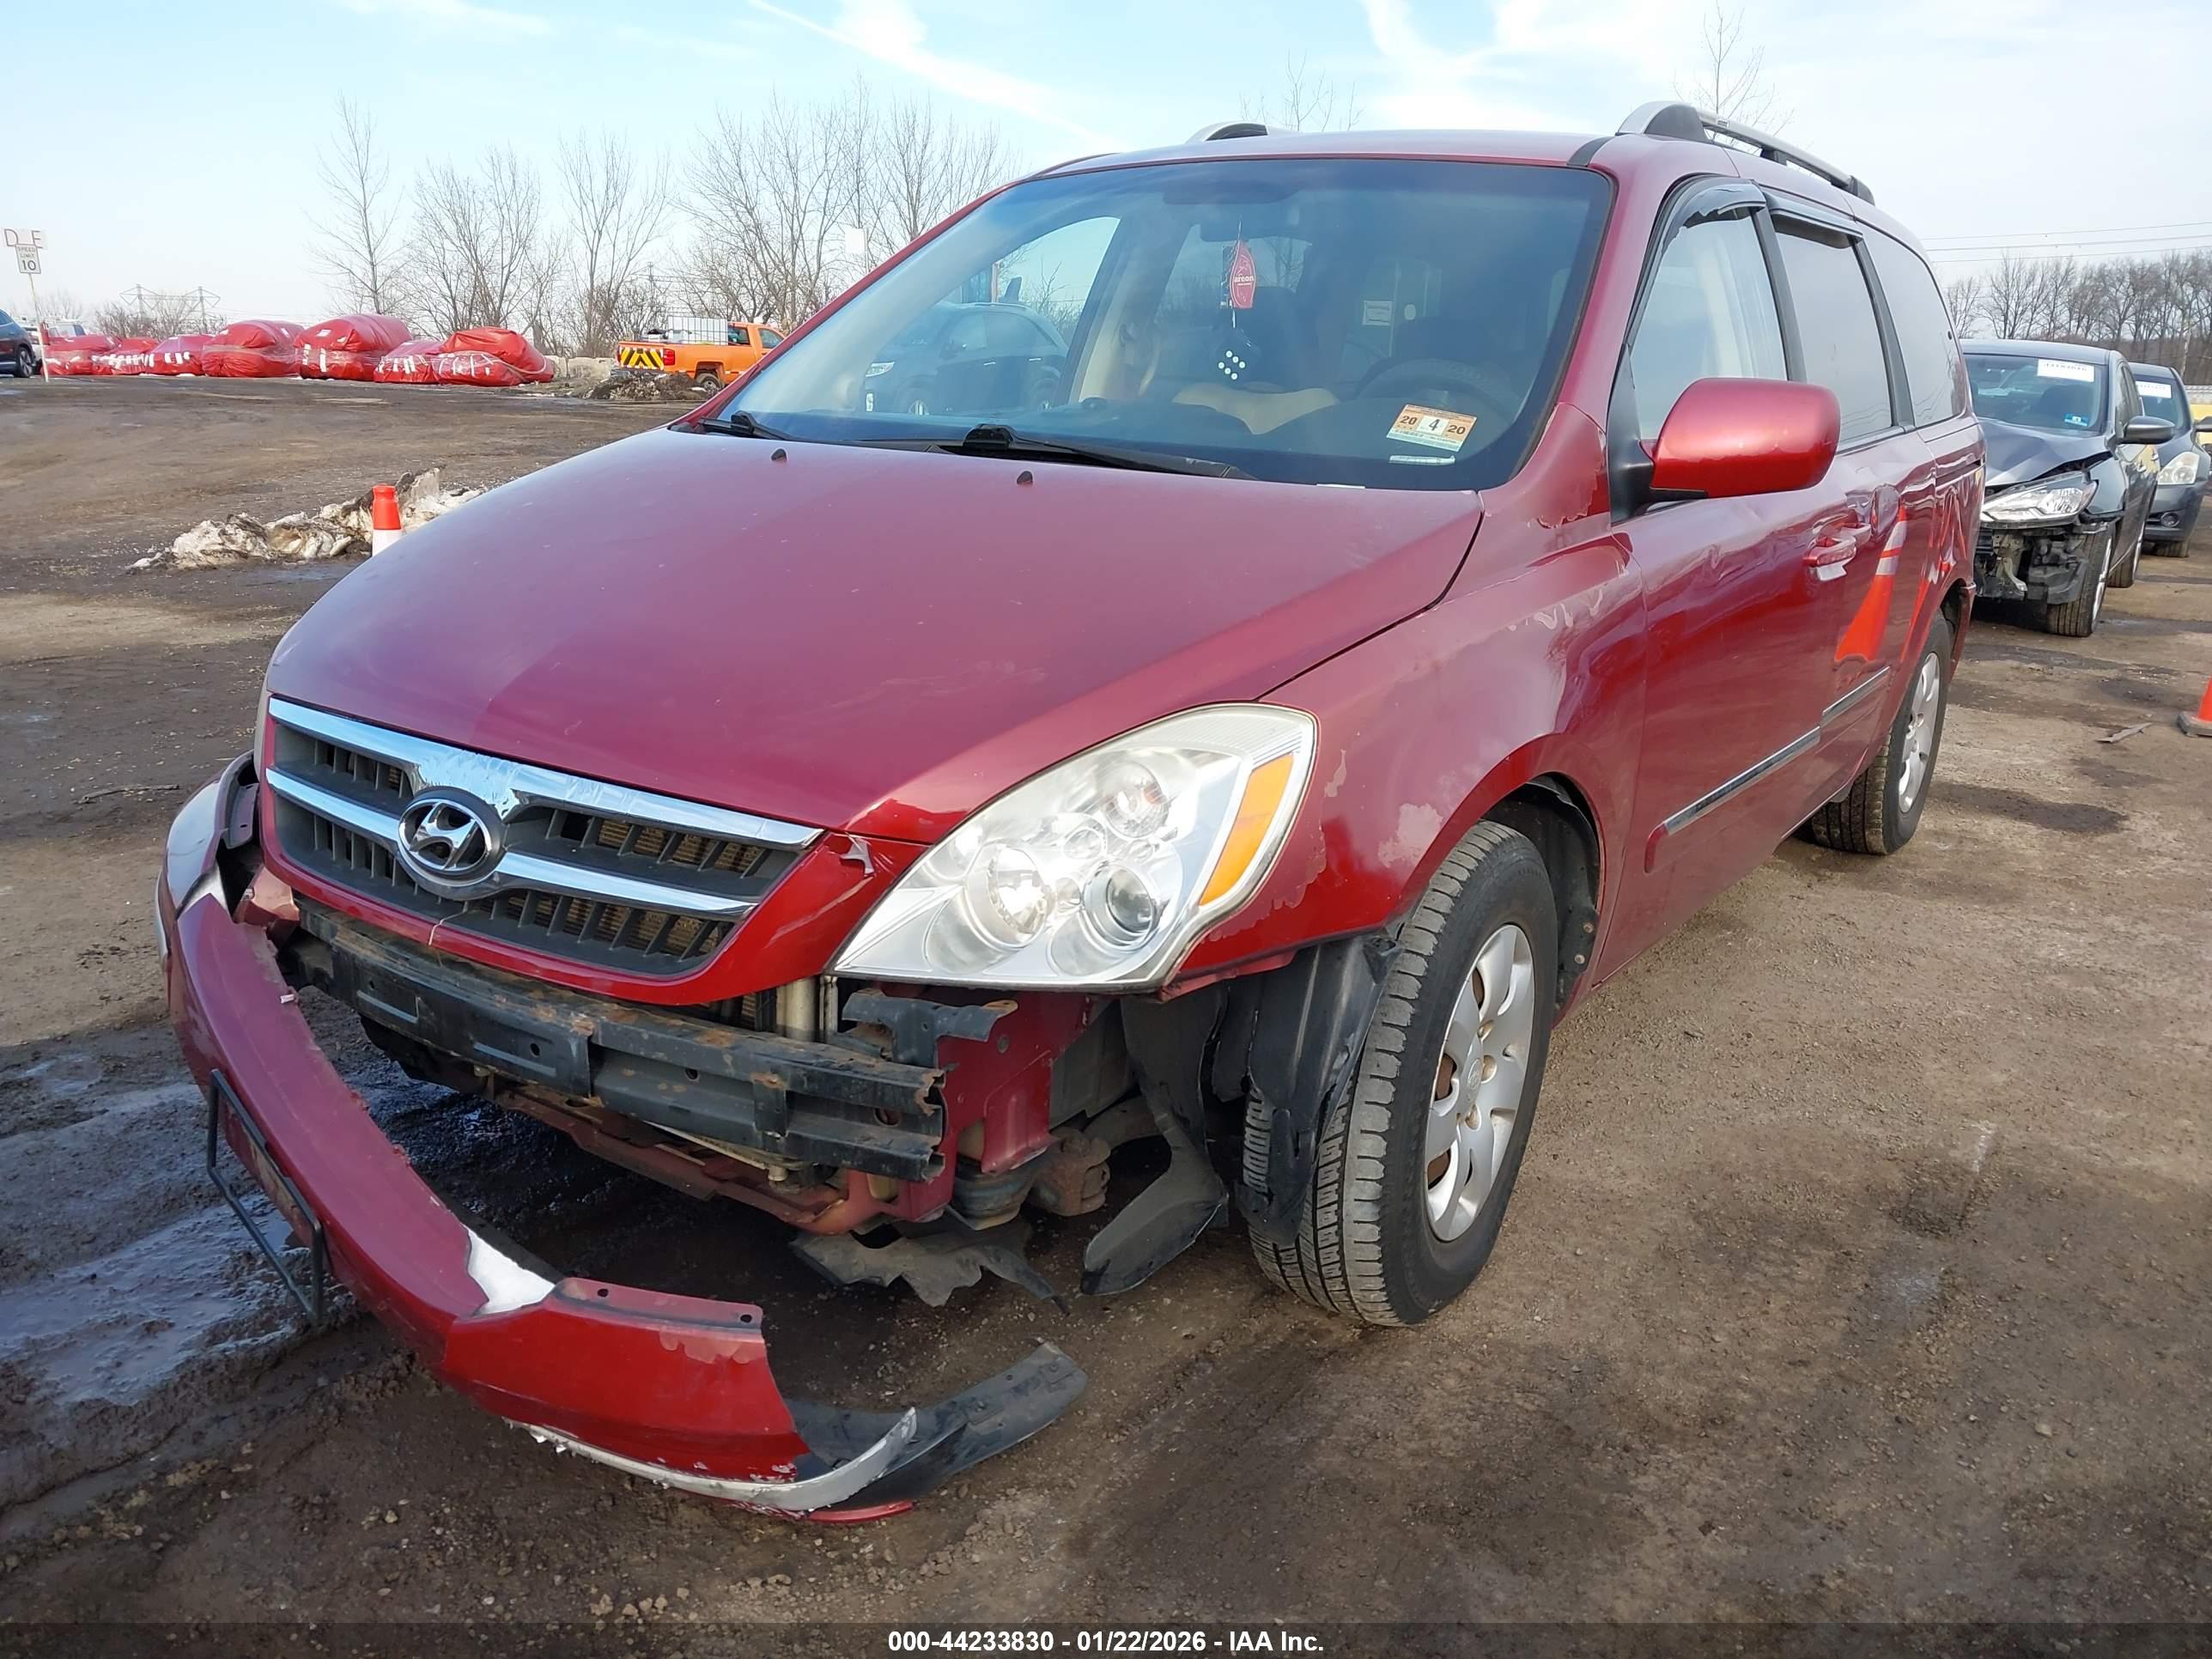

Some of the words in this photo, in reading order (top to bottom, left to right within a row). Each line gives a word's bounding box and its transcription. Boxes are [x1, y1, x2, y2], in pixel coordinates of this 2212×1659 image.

[4, 228, 18, 246] D
[21, 259, 36, 270] 10
[1400, 415, 1418, 426] 20
[1428, 418, 1441, 431] 4
[1447, 424, 1466, 434] 20
